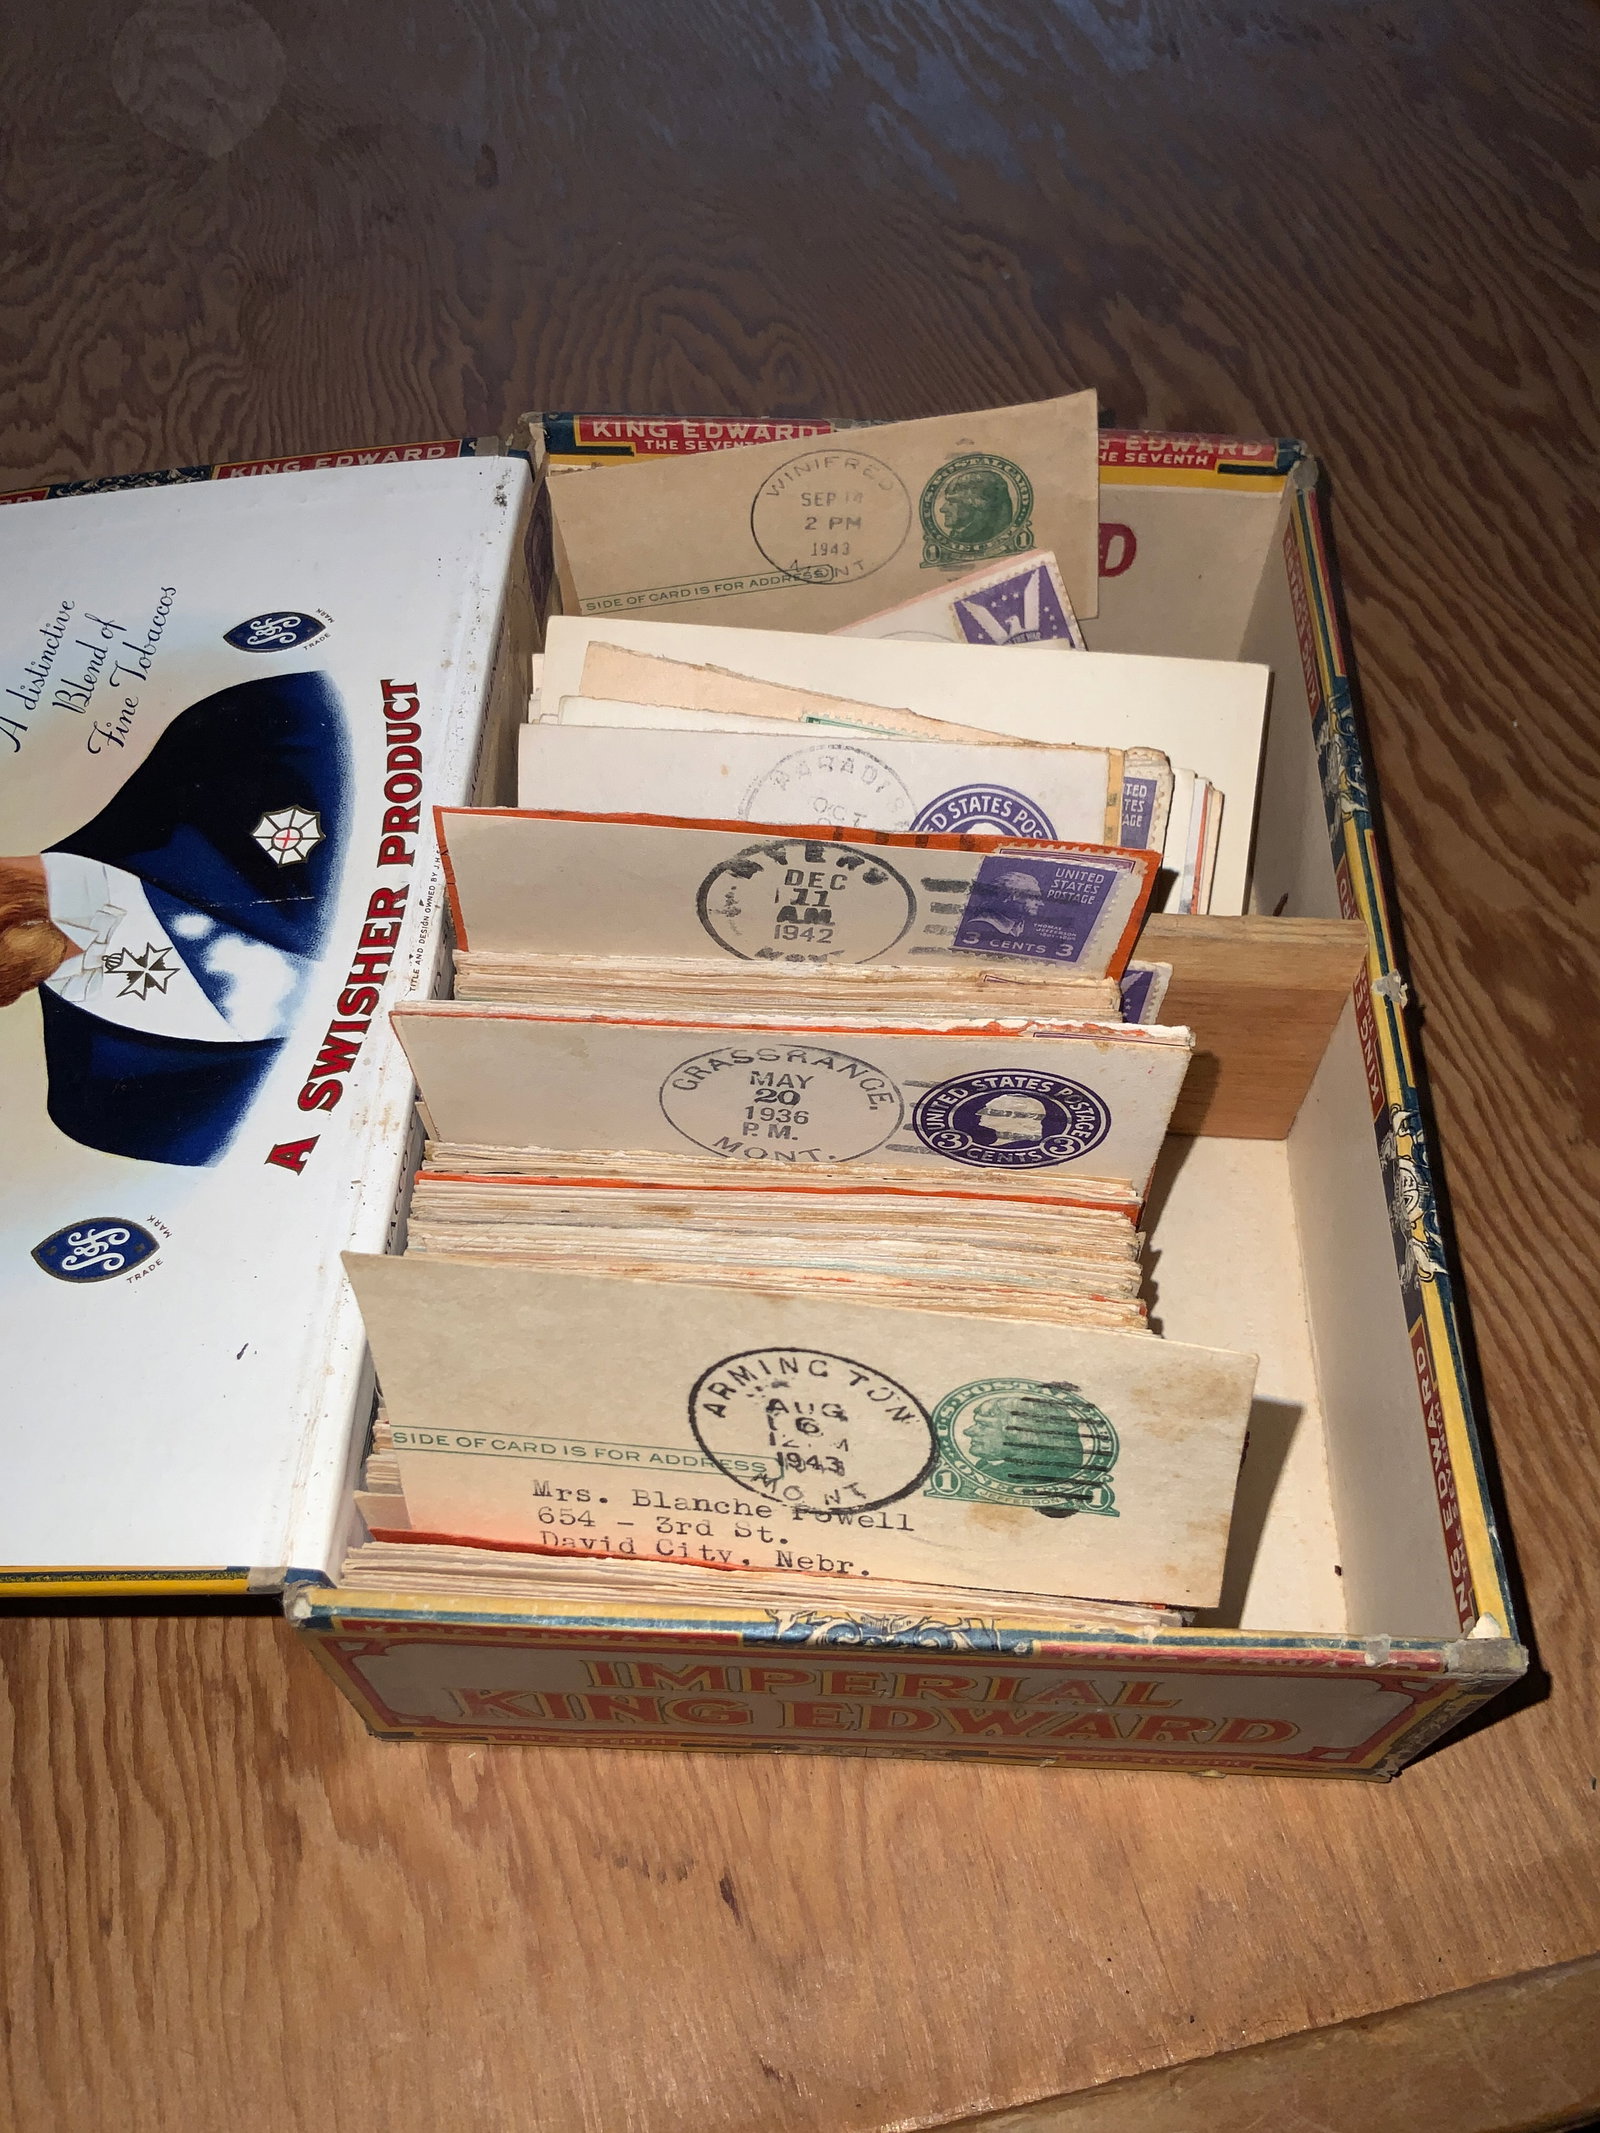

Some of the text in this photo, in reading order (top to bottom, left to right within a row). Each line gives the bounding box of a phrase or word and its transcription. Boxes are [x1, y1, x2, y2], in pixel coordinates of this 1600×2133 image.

[593, 420, 818, 440] KING EDWARD
[644, 440, 679, 450] THE
[1126, 435, 1263, 456] EDWARD
[230, 446, 446, 478] KING EDWARD
[1125, 453, 1208, 465] SEVENTH
[801, 492, 837, 507] SEP
[804, 516, 862, 530] 2 PM
[810, 542, 850, 557] 1943
[586, 569, 826, 611] SIDE OF CARD IS FOR ADDRESS
[302, 608, 335, 651] TRADE MARK
[0, 600, 75, 753] A distinctive
[52, 612, 128, 714] Blend of
[87, 586, 177, 754] Fine Tobaccos
[813, 797, 867, 827] OCT
[948, 795, 1013, 819] STATES
[430, 872, 438, 883] BY
[784, 869, 847, 890] DEC
[1051, 879, 1100, 895] STATES
[1055, 867, 1105, 884] UNITED
[426, 885, 436, 913] OWNED
[1047, 889, 1096, 905] POSTAGE
[264, 678, 423, 1176] A SWISHER PRODUCT
[418, 916, 430, 945] DESIGN
[774, 924, 834, 944] 1942
[416, 948, 424, 966] AND
[962, 931, 1074, 957] 3 CENTS 3
[410, 969, 420, 992] TITLE
[1360, 1017, 1379, 1101] KING
[750, 1070, 815, 1090] MAY
[753, 1088, 801, 1106] 20
[926, 1076, 1096, 1139] UNITED STATES POSTAGE
[745, 1105, 809, 1125] 1936
[937, 1132, 1077, 1163] 3 CENTS 3
[126, 1215, 173, 1284] TRADE MARK
[703, 1357, 916, 1424] ARMINGTON
[1415, 1346, 1454, 1530] EDWARD
[393, 1432, 768, 1473] SIDE OF CARD IS FOR ADDRESS
[1434, 1401, 1459, 1519] SEVENTH
[940, 1472, 954, 1491] 1
[532, 1480, 915, 1532] Mrs. Blanche Powell
[978, 1489, 1062, 1505] JEFFERSON
[1091, 1487, 1103, 1506] 1
[538, 1506, 596, 1527] 654
[655, 1516, 714, 1537] 3rd
[734, 1521, 788, 1545] St.
[540, 1530, 636, 1555] David
[775, 1550, 870, 1577] Nebr.
[580, 1659, 1182, 1709] IMPERIAL
[446, 1687, 1301, 1746] KING EDWARD
